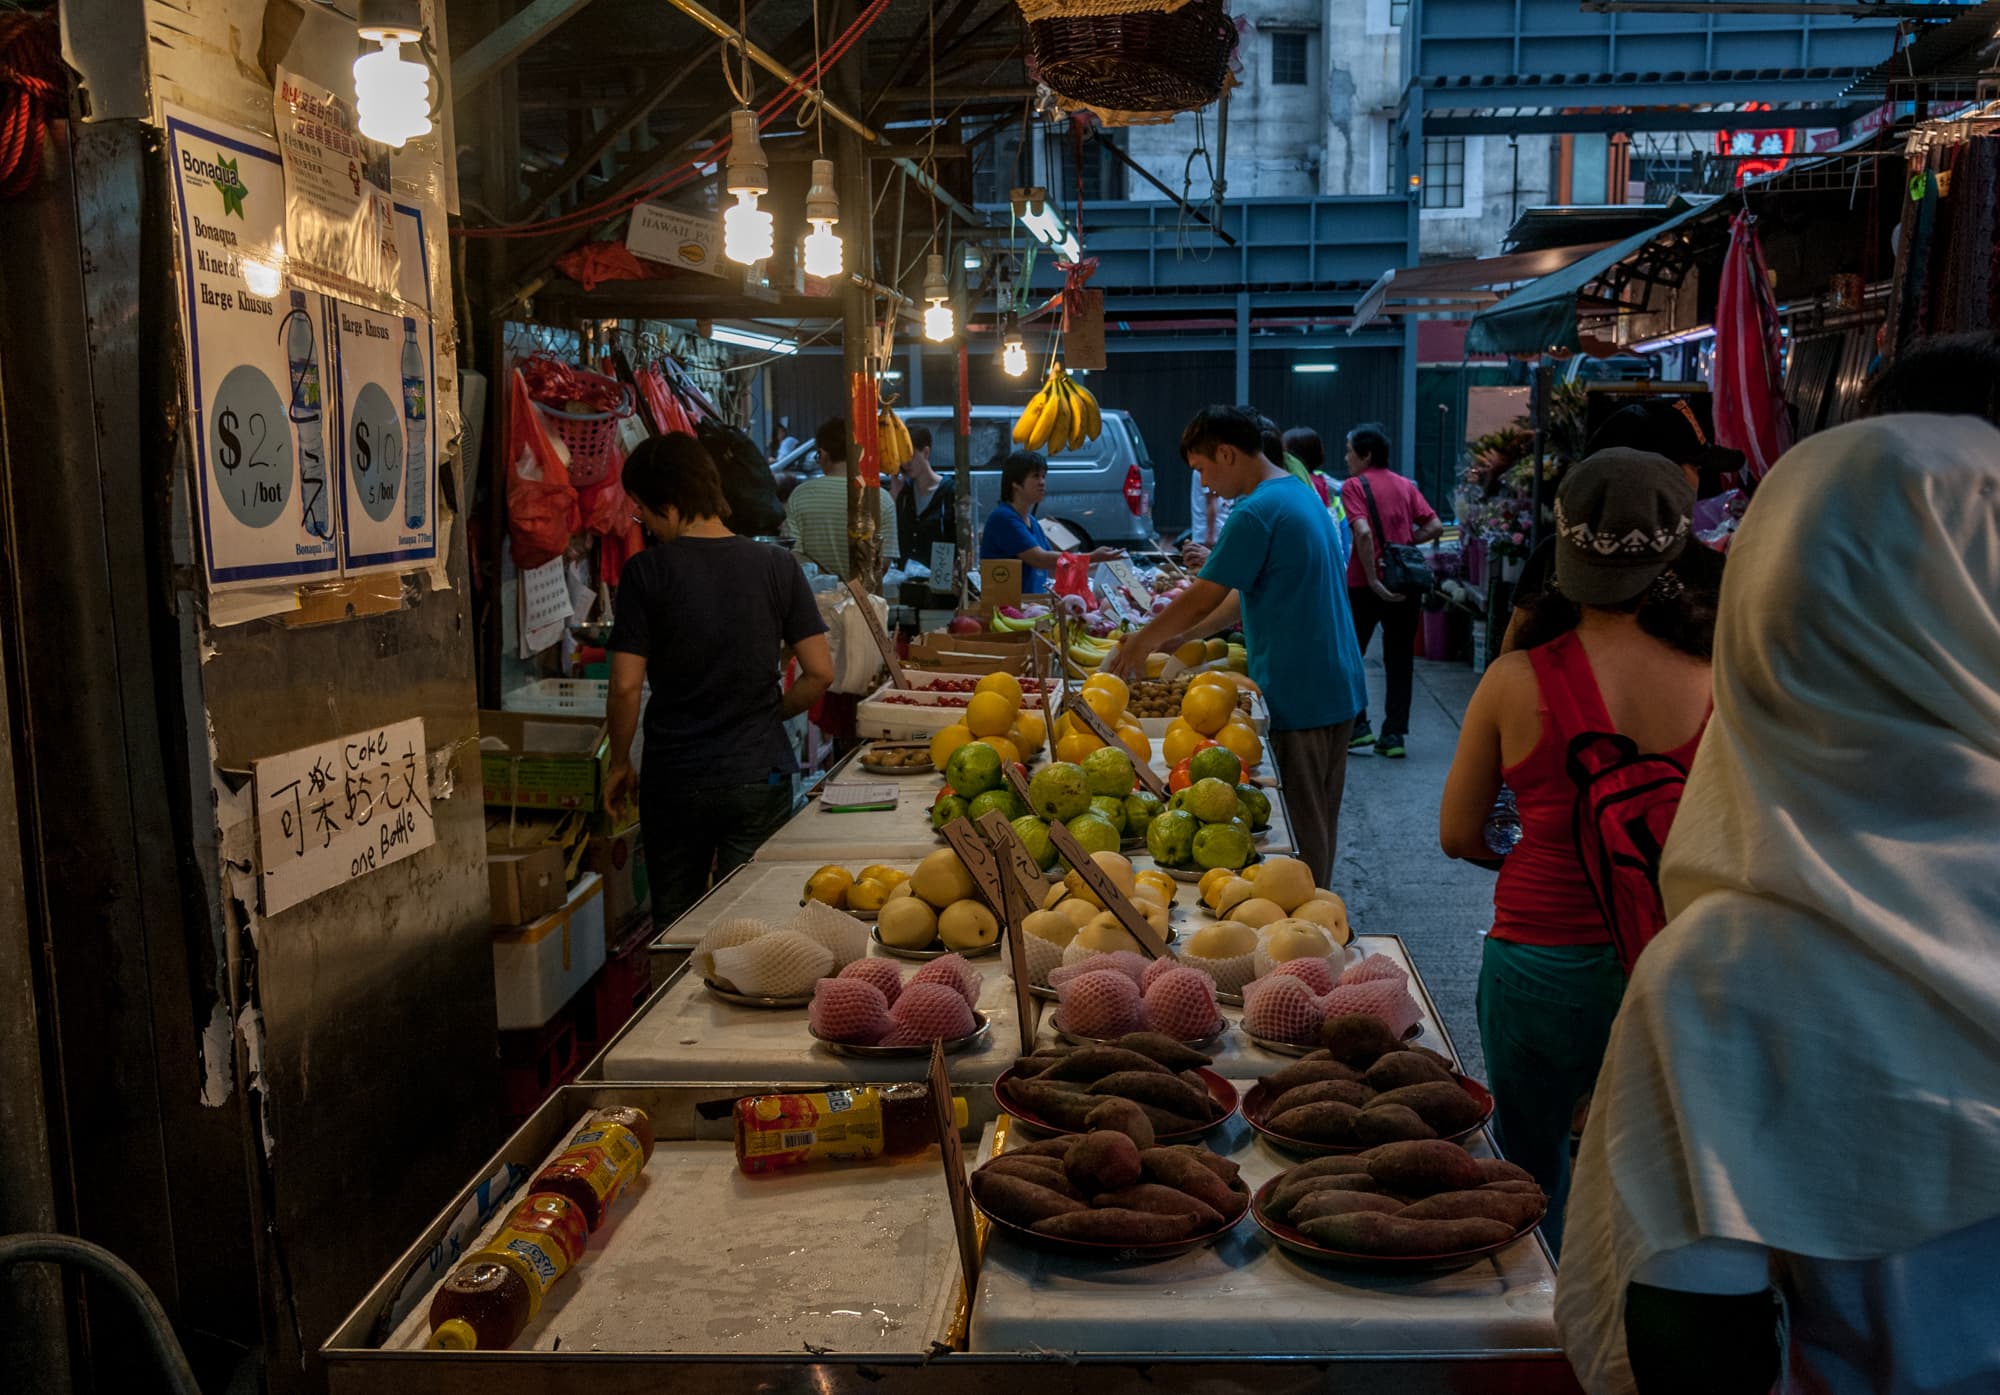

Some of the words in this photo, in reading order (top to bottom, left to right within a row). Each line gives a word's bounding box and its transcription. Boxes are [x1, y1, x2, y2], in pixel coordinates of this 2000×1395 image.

[182, 149, 238, 187] Bonaqua
[194, 215, 237, 247] Bonaqua
[641, 216, 689, 237] HAWAII
[200, 283, 233, 312] Harge
[237, 290, 273, 316] Khusus
[341, 313, 362, 337] Harge
[365, 318, 389, 340] Khusus
[344, 731, 388, 771] Coke
[351, 846, 376, 877] one
[380, 807, 416, 860] Bottle
